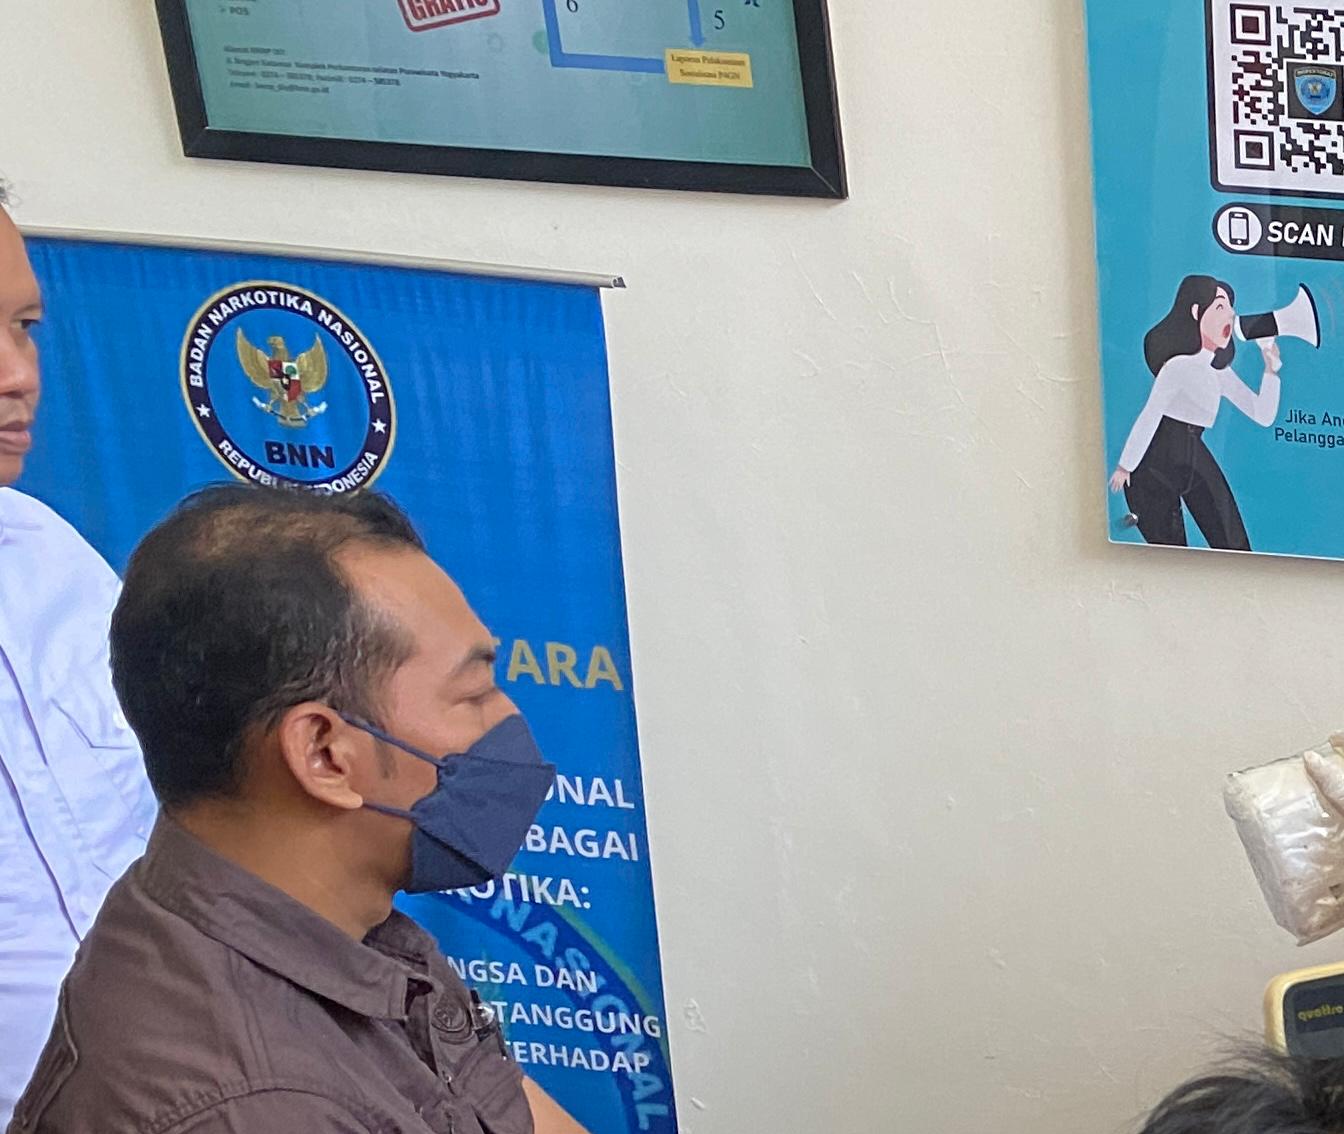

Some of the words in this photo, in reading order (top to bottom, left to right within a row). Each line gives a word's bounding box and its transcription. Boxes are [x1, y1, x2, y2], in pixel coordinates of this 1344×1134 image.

[714, 10, 725, 30] 5
[1267, 221, 1334, 247] SCAN
[189, 324, 213, 388] BADAN
[207, 290, 313, 327] NARKOTIKA
[318, 308, 385, 404] NASIONAL
[1285, 409, 1317, 425] Jika
[264, 440, 336, 470] BNN
[493, 636, 624, 691] ARA
[518, 823, 640, 862] BAGAI
[534, 964, 598, 993] DAN
